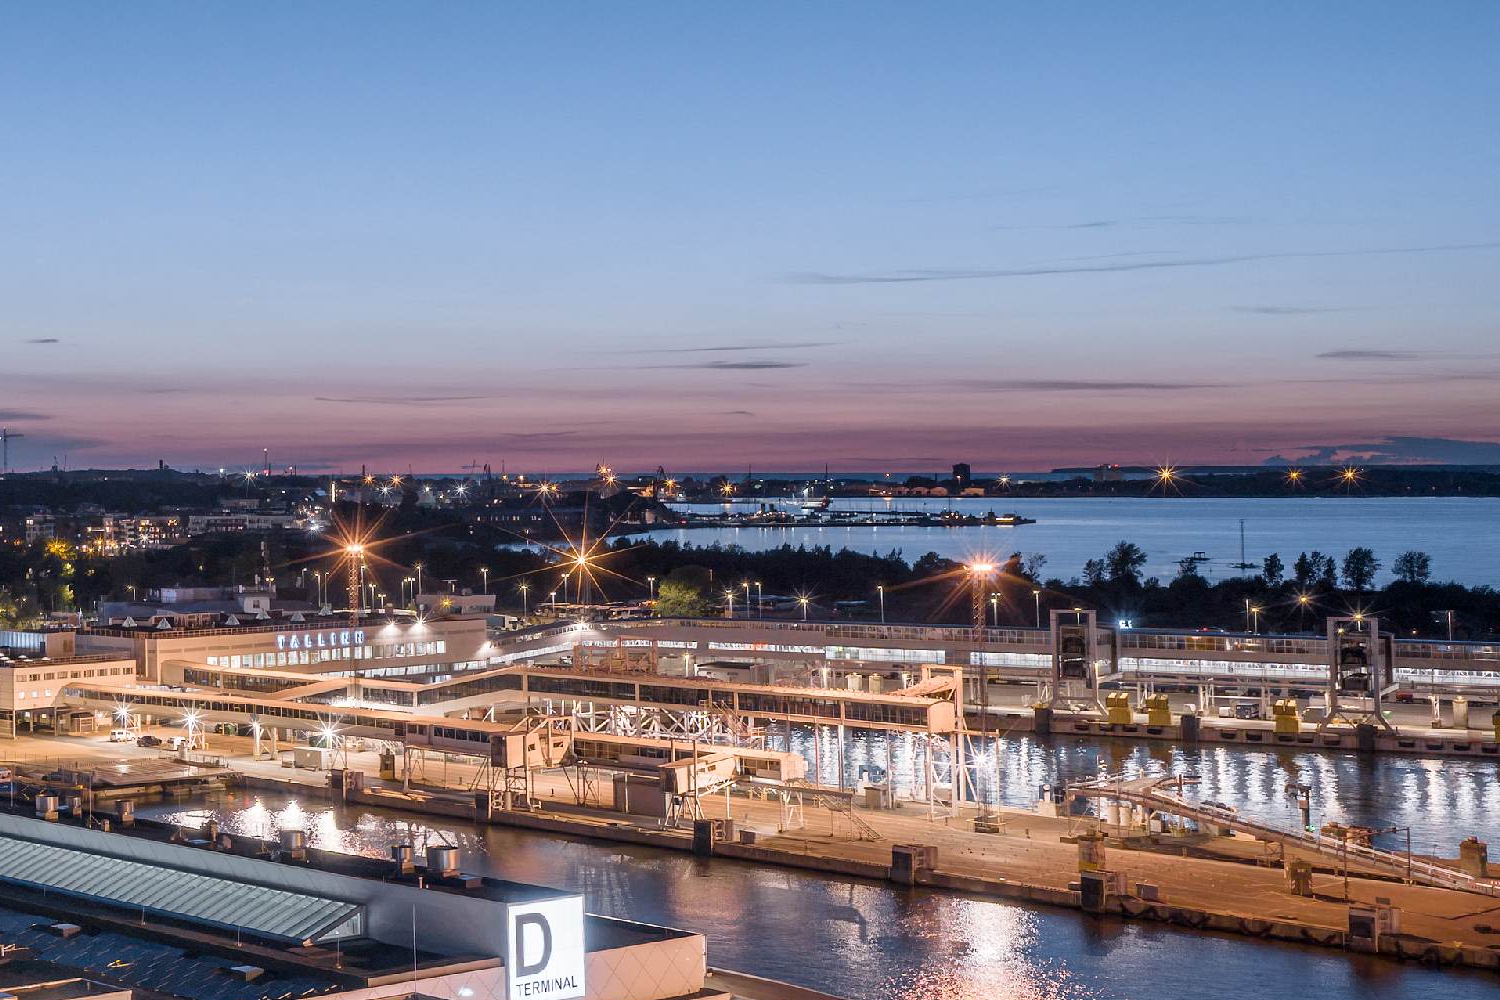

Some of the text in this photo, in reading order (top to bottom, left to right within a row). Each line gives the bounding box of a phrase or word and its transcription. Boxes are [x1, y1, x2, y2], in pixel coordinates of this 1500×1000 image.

[277, 630, 365, 650] TALLINN
[515, 912, 553, 979] D
[515, 975, 578, 997] TERMINAL
